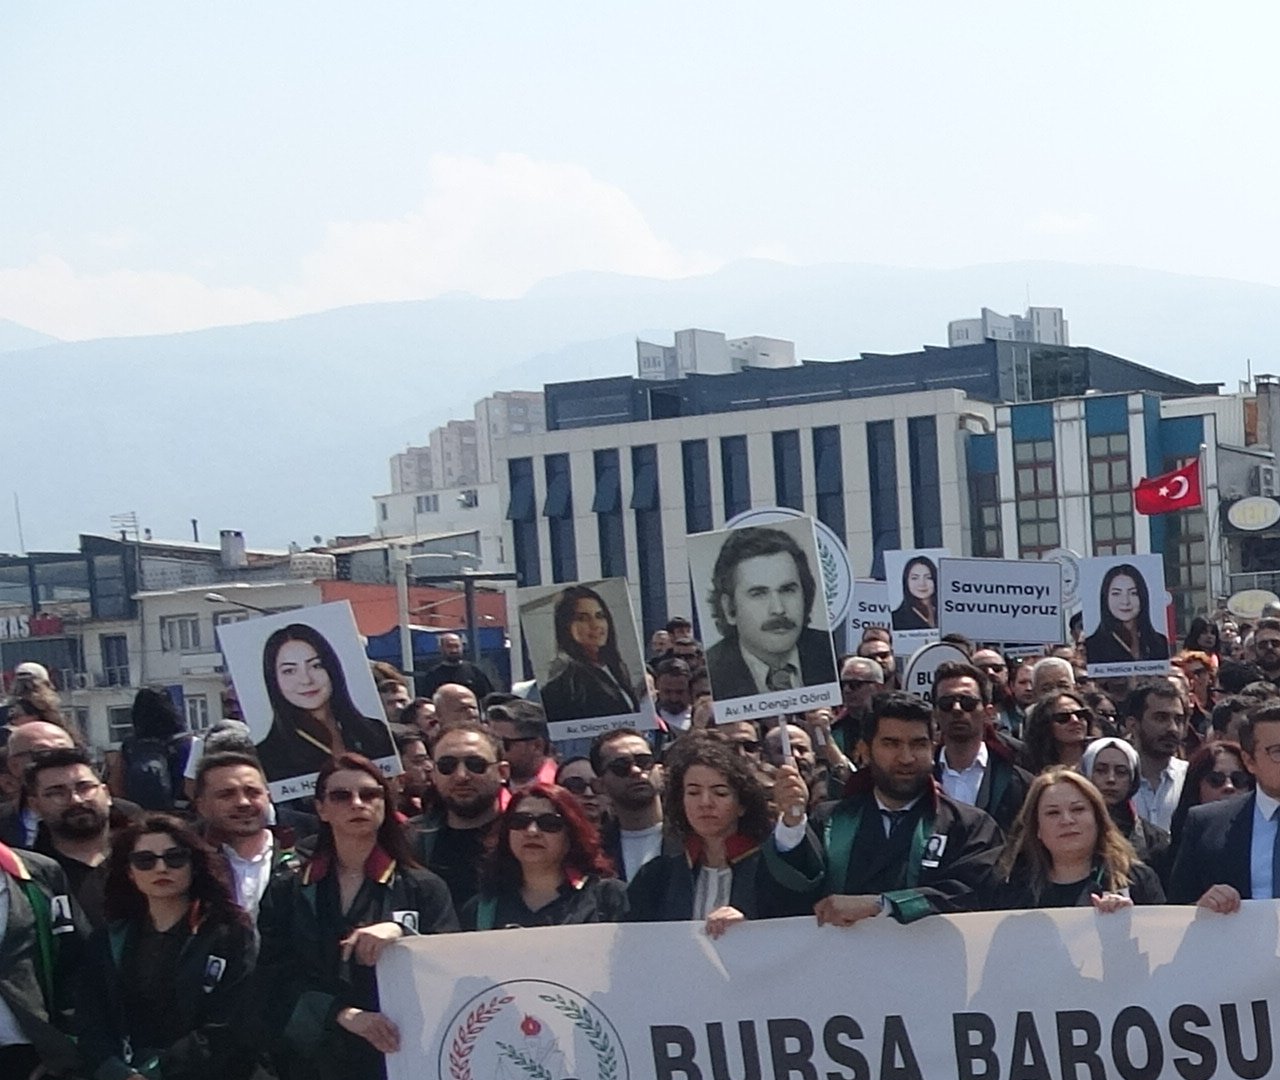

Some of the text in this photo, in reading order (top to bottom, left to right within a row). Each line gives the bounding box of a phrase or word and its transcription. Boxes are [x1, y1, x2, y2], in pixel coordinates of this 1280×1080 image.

[951, 580, 1050, 599] Savunmayı
[944, 600, 1058, 618] Savunuyoruz
[725, 706, 740, 717] Av.
[743, 703, 757, 713] M.
[760, 696, 798, 710] Cengiz
